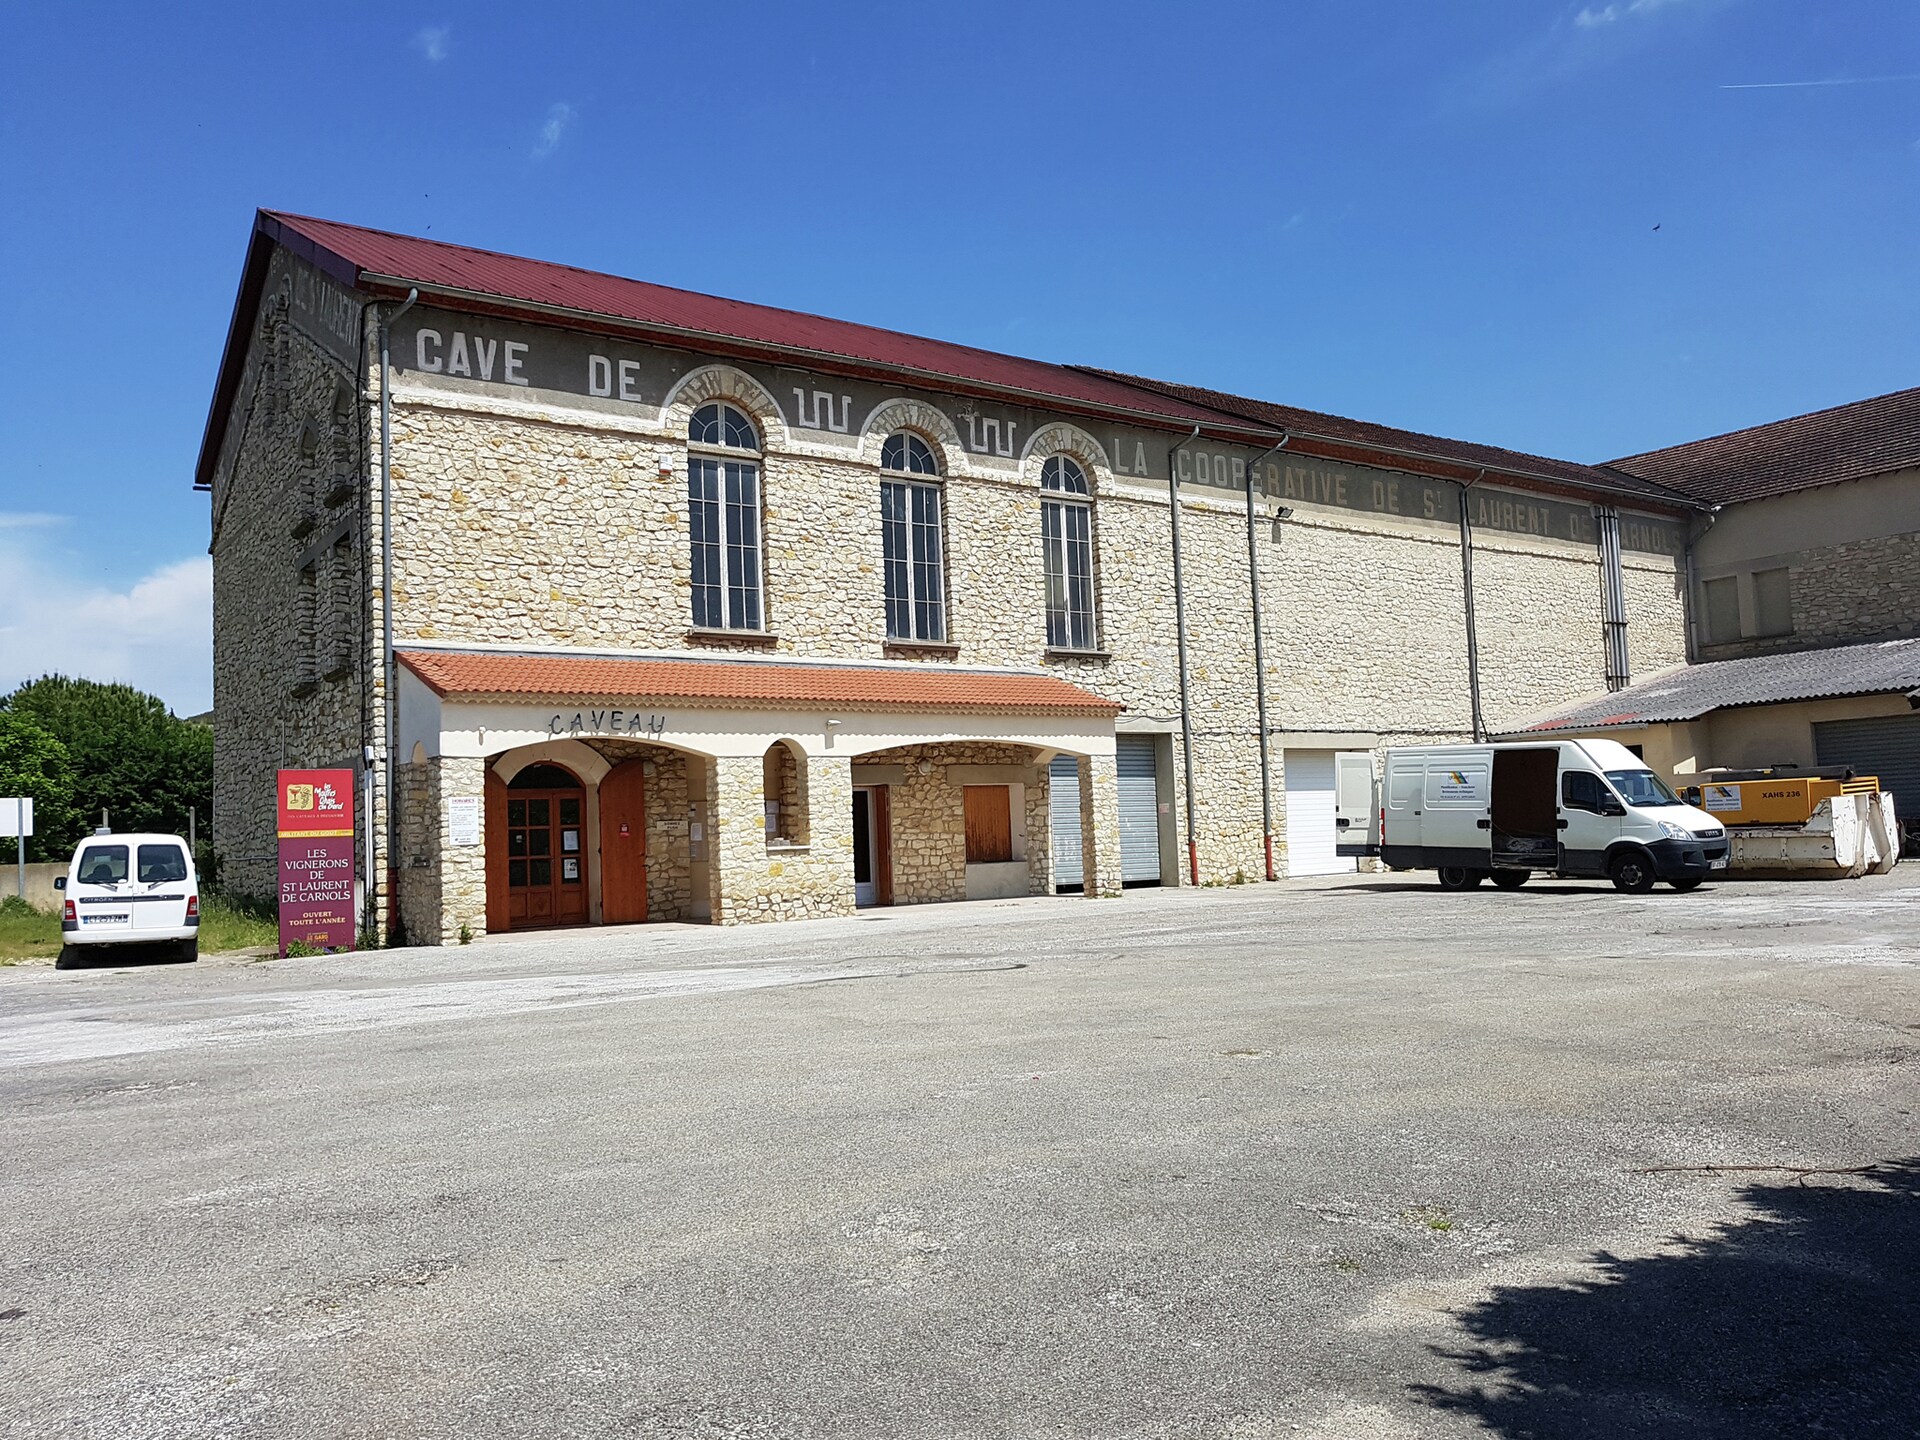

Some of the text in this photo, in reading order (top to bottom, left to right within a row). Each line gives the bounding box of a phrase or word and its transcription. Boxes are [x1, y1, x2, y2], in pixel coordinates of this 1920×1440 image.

[416, 328, 529, 387] CAVE
[589, 354, 642, 402] DE
[1114, 438, 1148, 475] LA
[1372, 480, 1400, 513] DE
[549, 710, 665, 734] CAVEAU
[307, 849, 327, 859] LES
[285, 859, 349, 870] VIGNERONS
[310, 871, 324, 880] DE
[283, 880, 349, 892] ST LAURENT
[282, 890, 351, 903] DE CARNOLS
